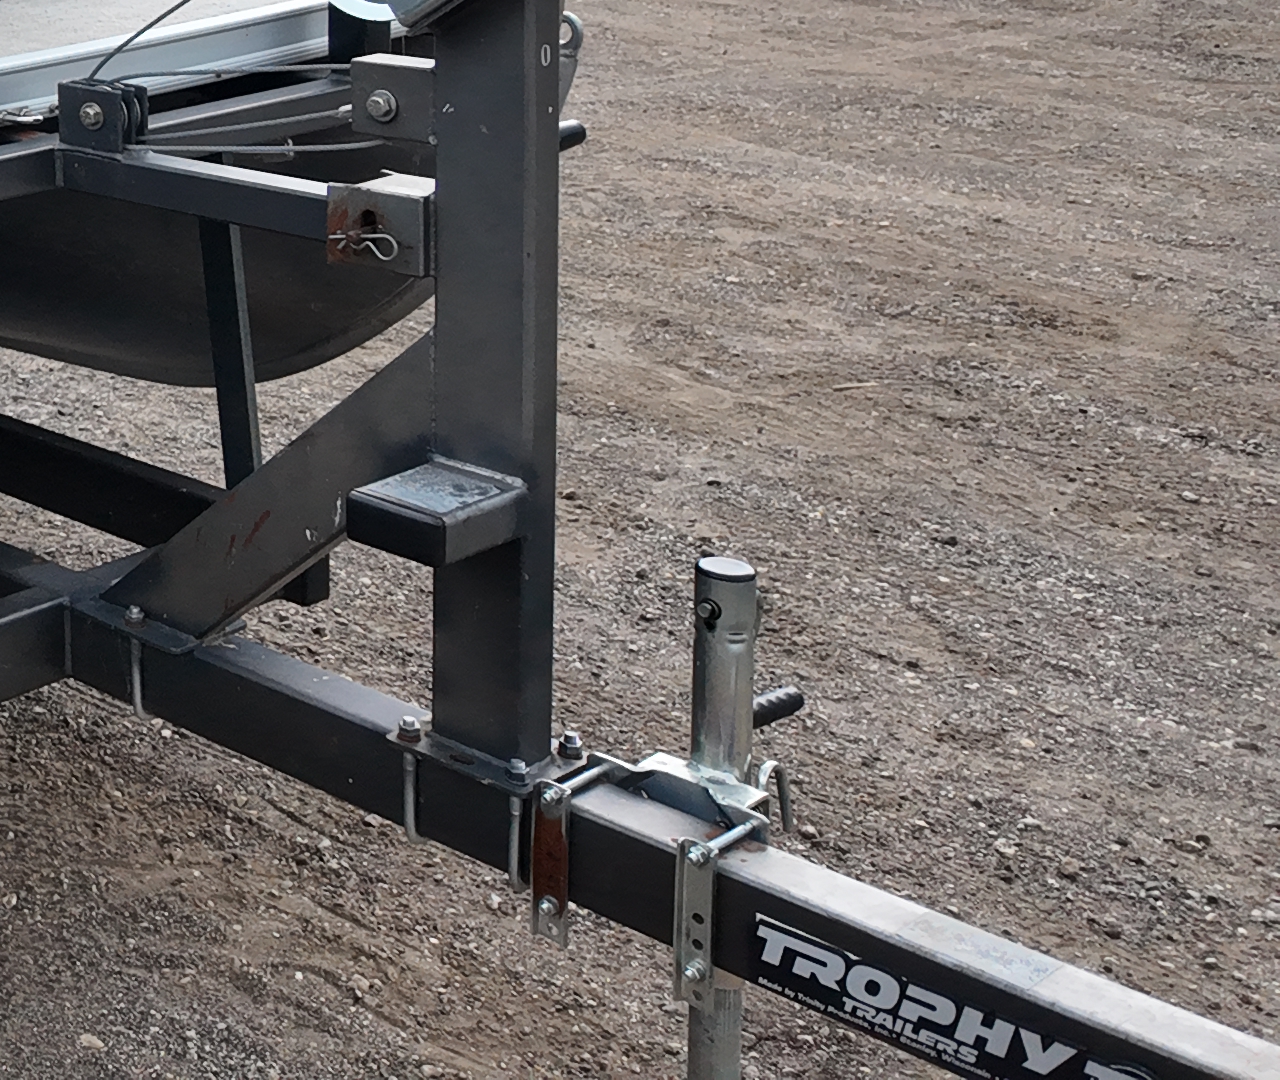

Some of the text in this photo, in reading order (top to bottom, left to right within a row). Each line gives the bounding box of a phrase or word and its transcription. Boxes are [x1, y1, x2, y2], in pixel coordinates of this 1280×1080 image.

[756, 924, 1079, 1076] TROPHY
[757, 976, 783, 993] Made
[784, 987, 796, 999] by
[842, 996, 979, 1064] TRAILERS
